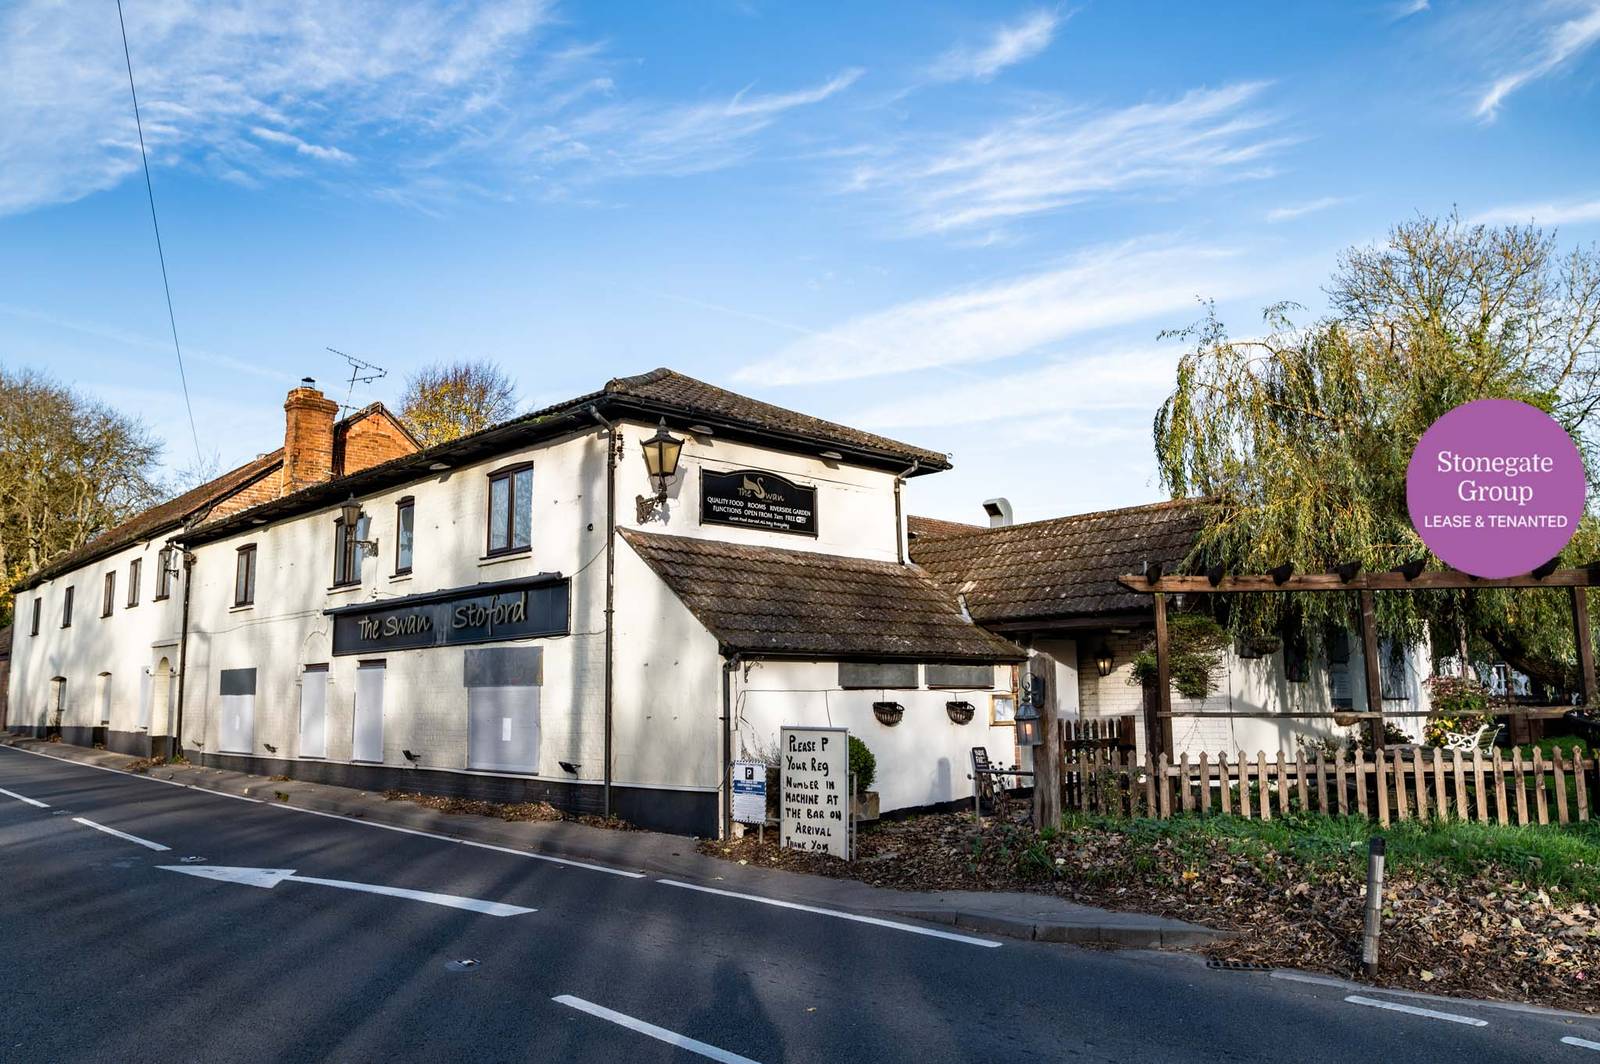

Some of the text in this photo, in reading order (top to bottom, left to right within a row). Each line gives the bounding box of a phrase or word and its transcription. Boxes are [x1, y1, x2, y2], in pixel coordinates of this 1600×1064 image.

[737, 487, 752, 498] The
[707, 496, 811, 516] QUALITY FOOD ROOMS RIVERSIDE GARDEN
[713, 505, 742, 515] FUNCTIONS
[744, 509, 758, 517] OPEN
[758, 511, 773, 519] FROM
[358, 591, 527, 641] The Swan Stoford
[826, 781, 835, 790] IN
[785, 792, 839, 806] MACHINE AT
[785, 807, 842, 821] THE BAR ON
[795, 822, 832, 837] ARRIVAL
